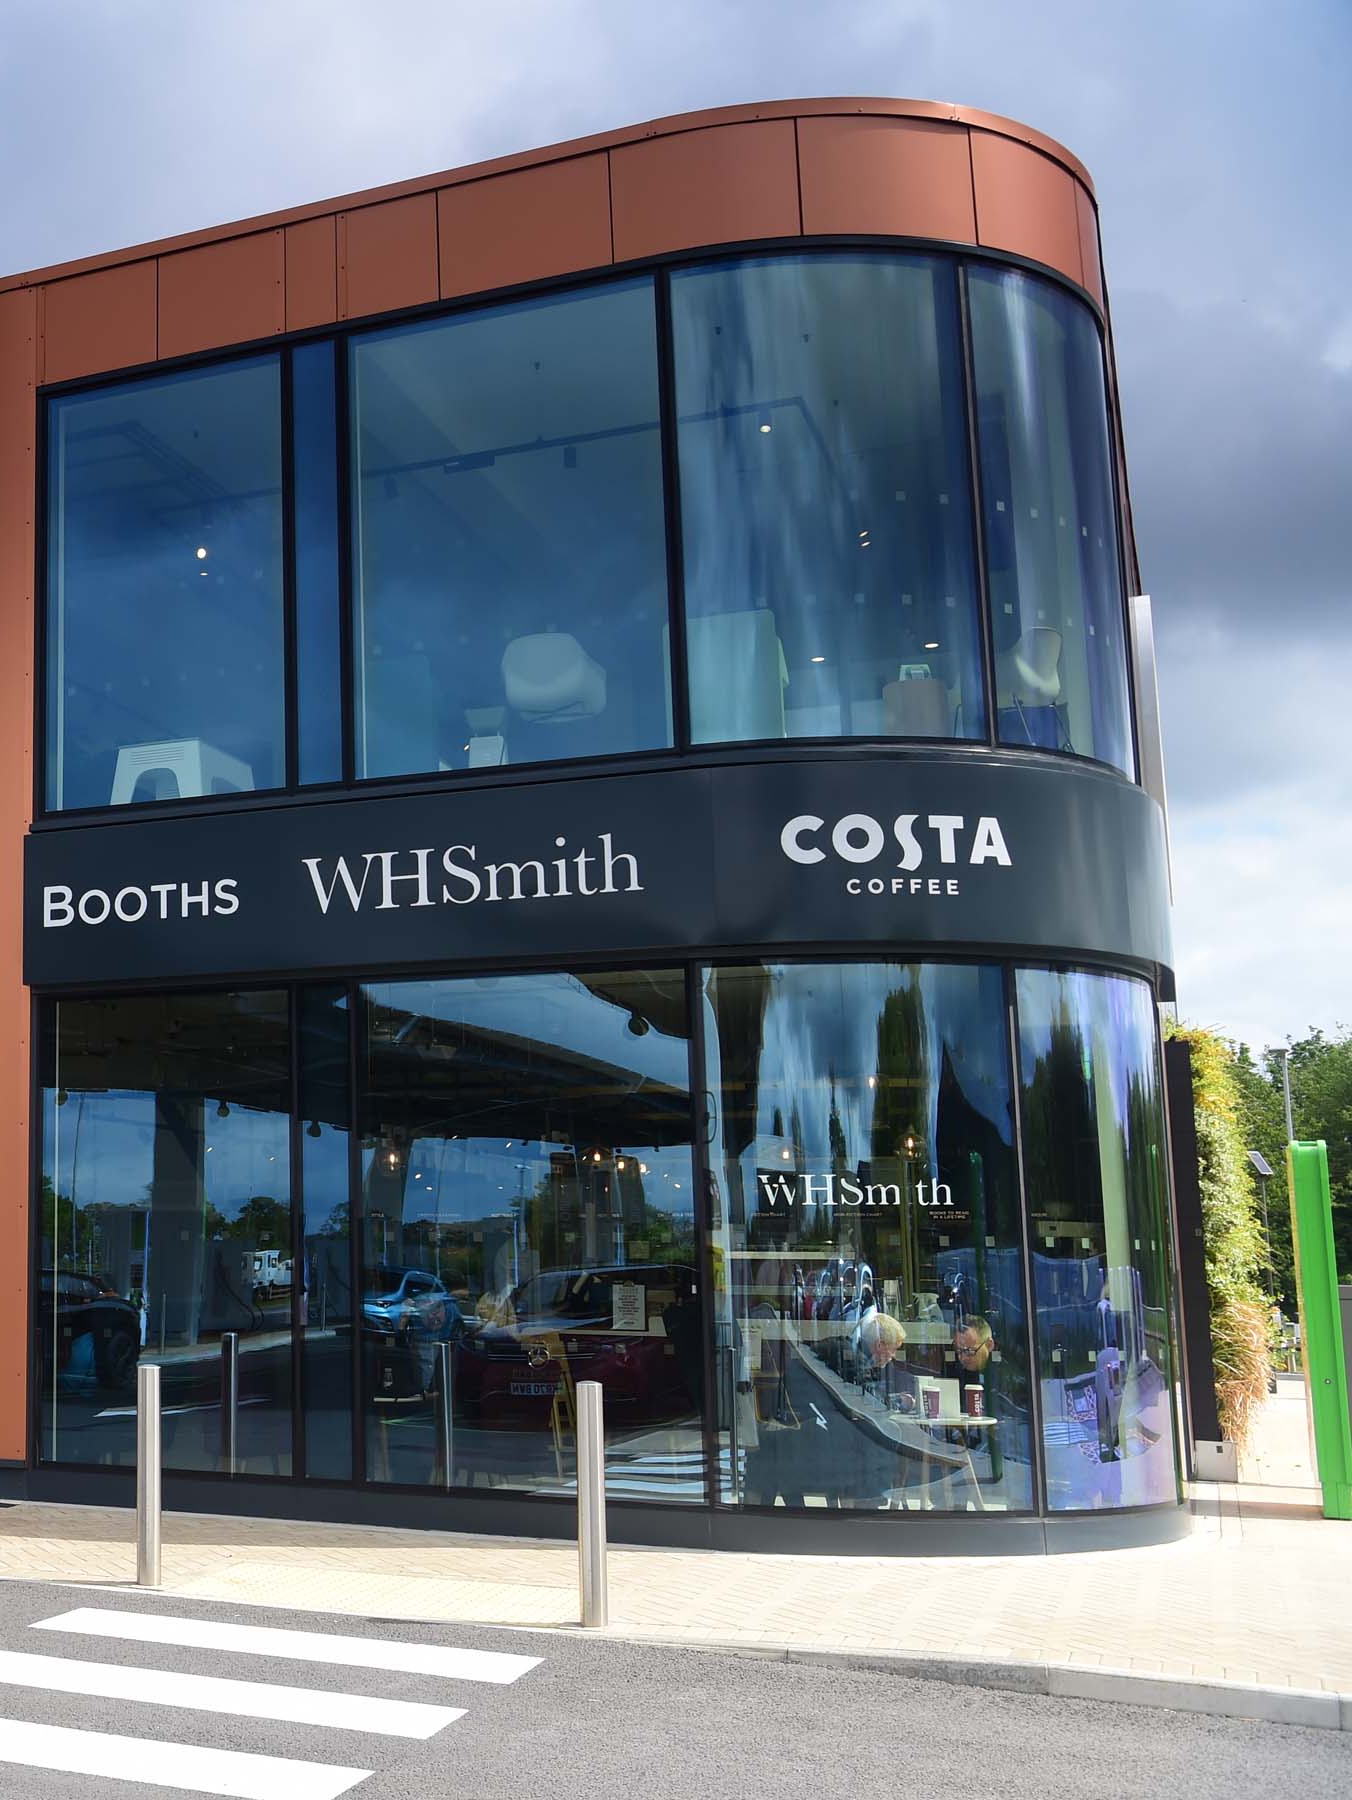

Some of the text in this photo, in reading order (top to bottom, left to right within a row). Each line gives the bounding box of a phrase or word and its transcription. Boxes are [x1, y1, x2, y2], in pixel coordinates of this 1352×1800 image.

[780, 813, 1013, 872] COSTA
[301, 832, 645, 915] WHSmith
[846, 878, 960, 896] COFFEE
[758, 1173, 955, 1206] WHSmth
